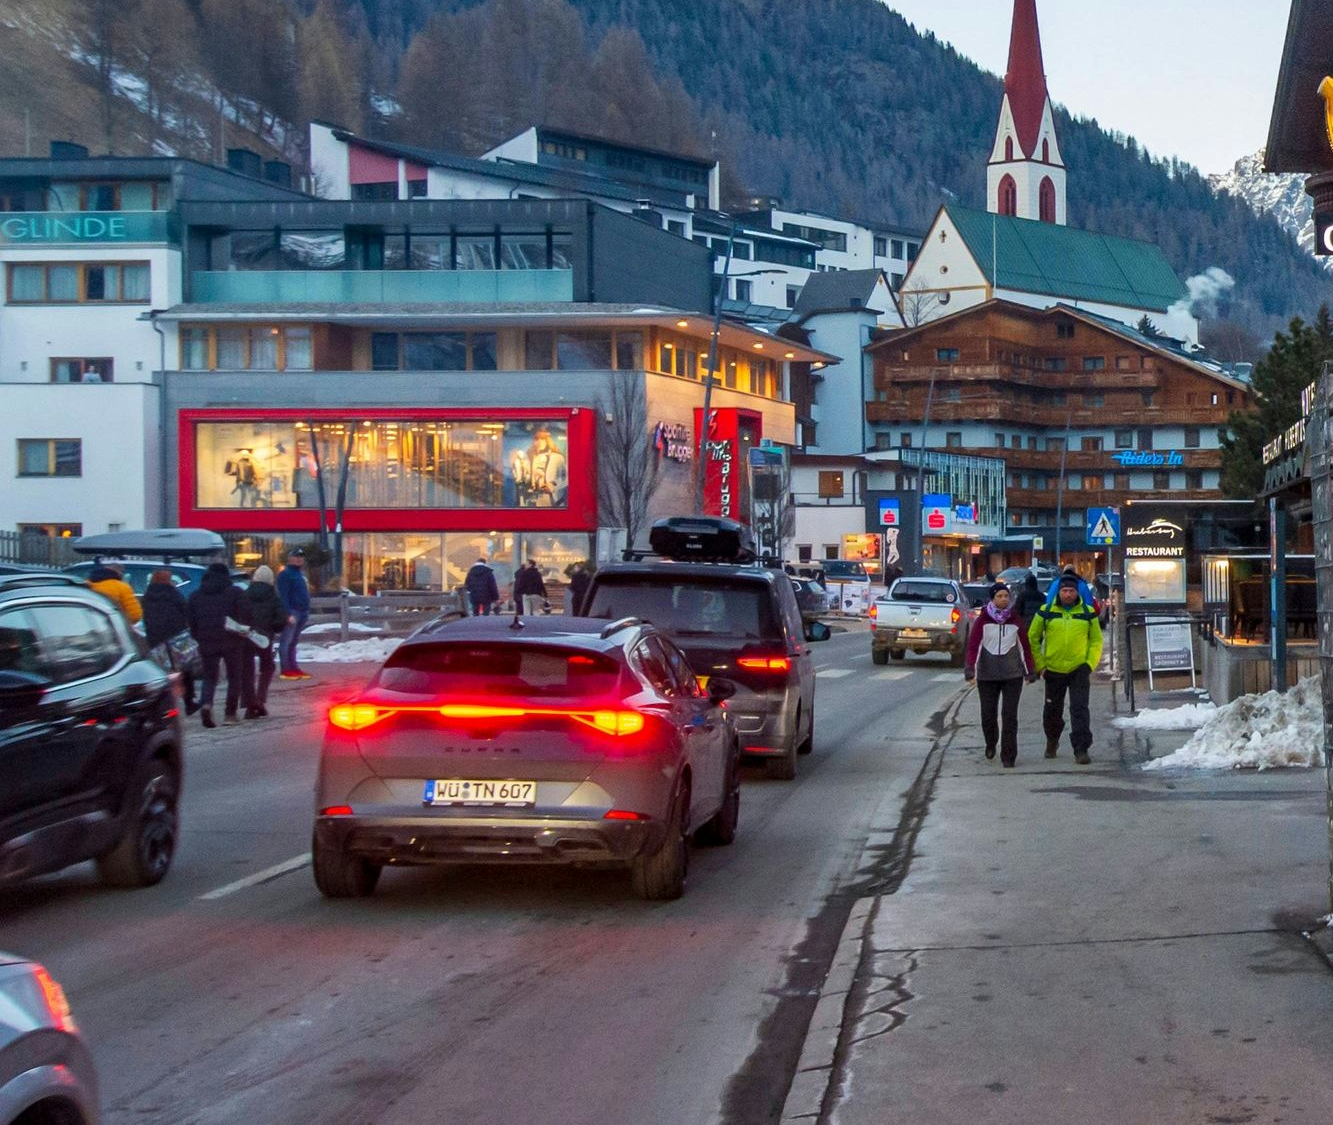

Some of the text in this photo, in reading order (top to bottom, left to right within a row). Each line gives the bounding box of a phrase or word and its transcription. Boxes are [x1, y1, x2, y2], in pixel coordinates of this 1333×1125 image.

[0, 217, 126, 238] GLINDE
[1126, 547, 1184, 556] RESTAURANT
[437, 783, 532, 799] WÜ TN 607
